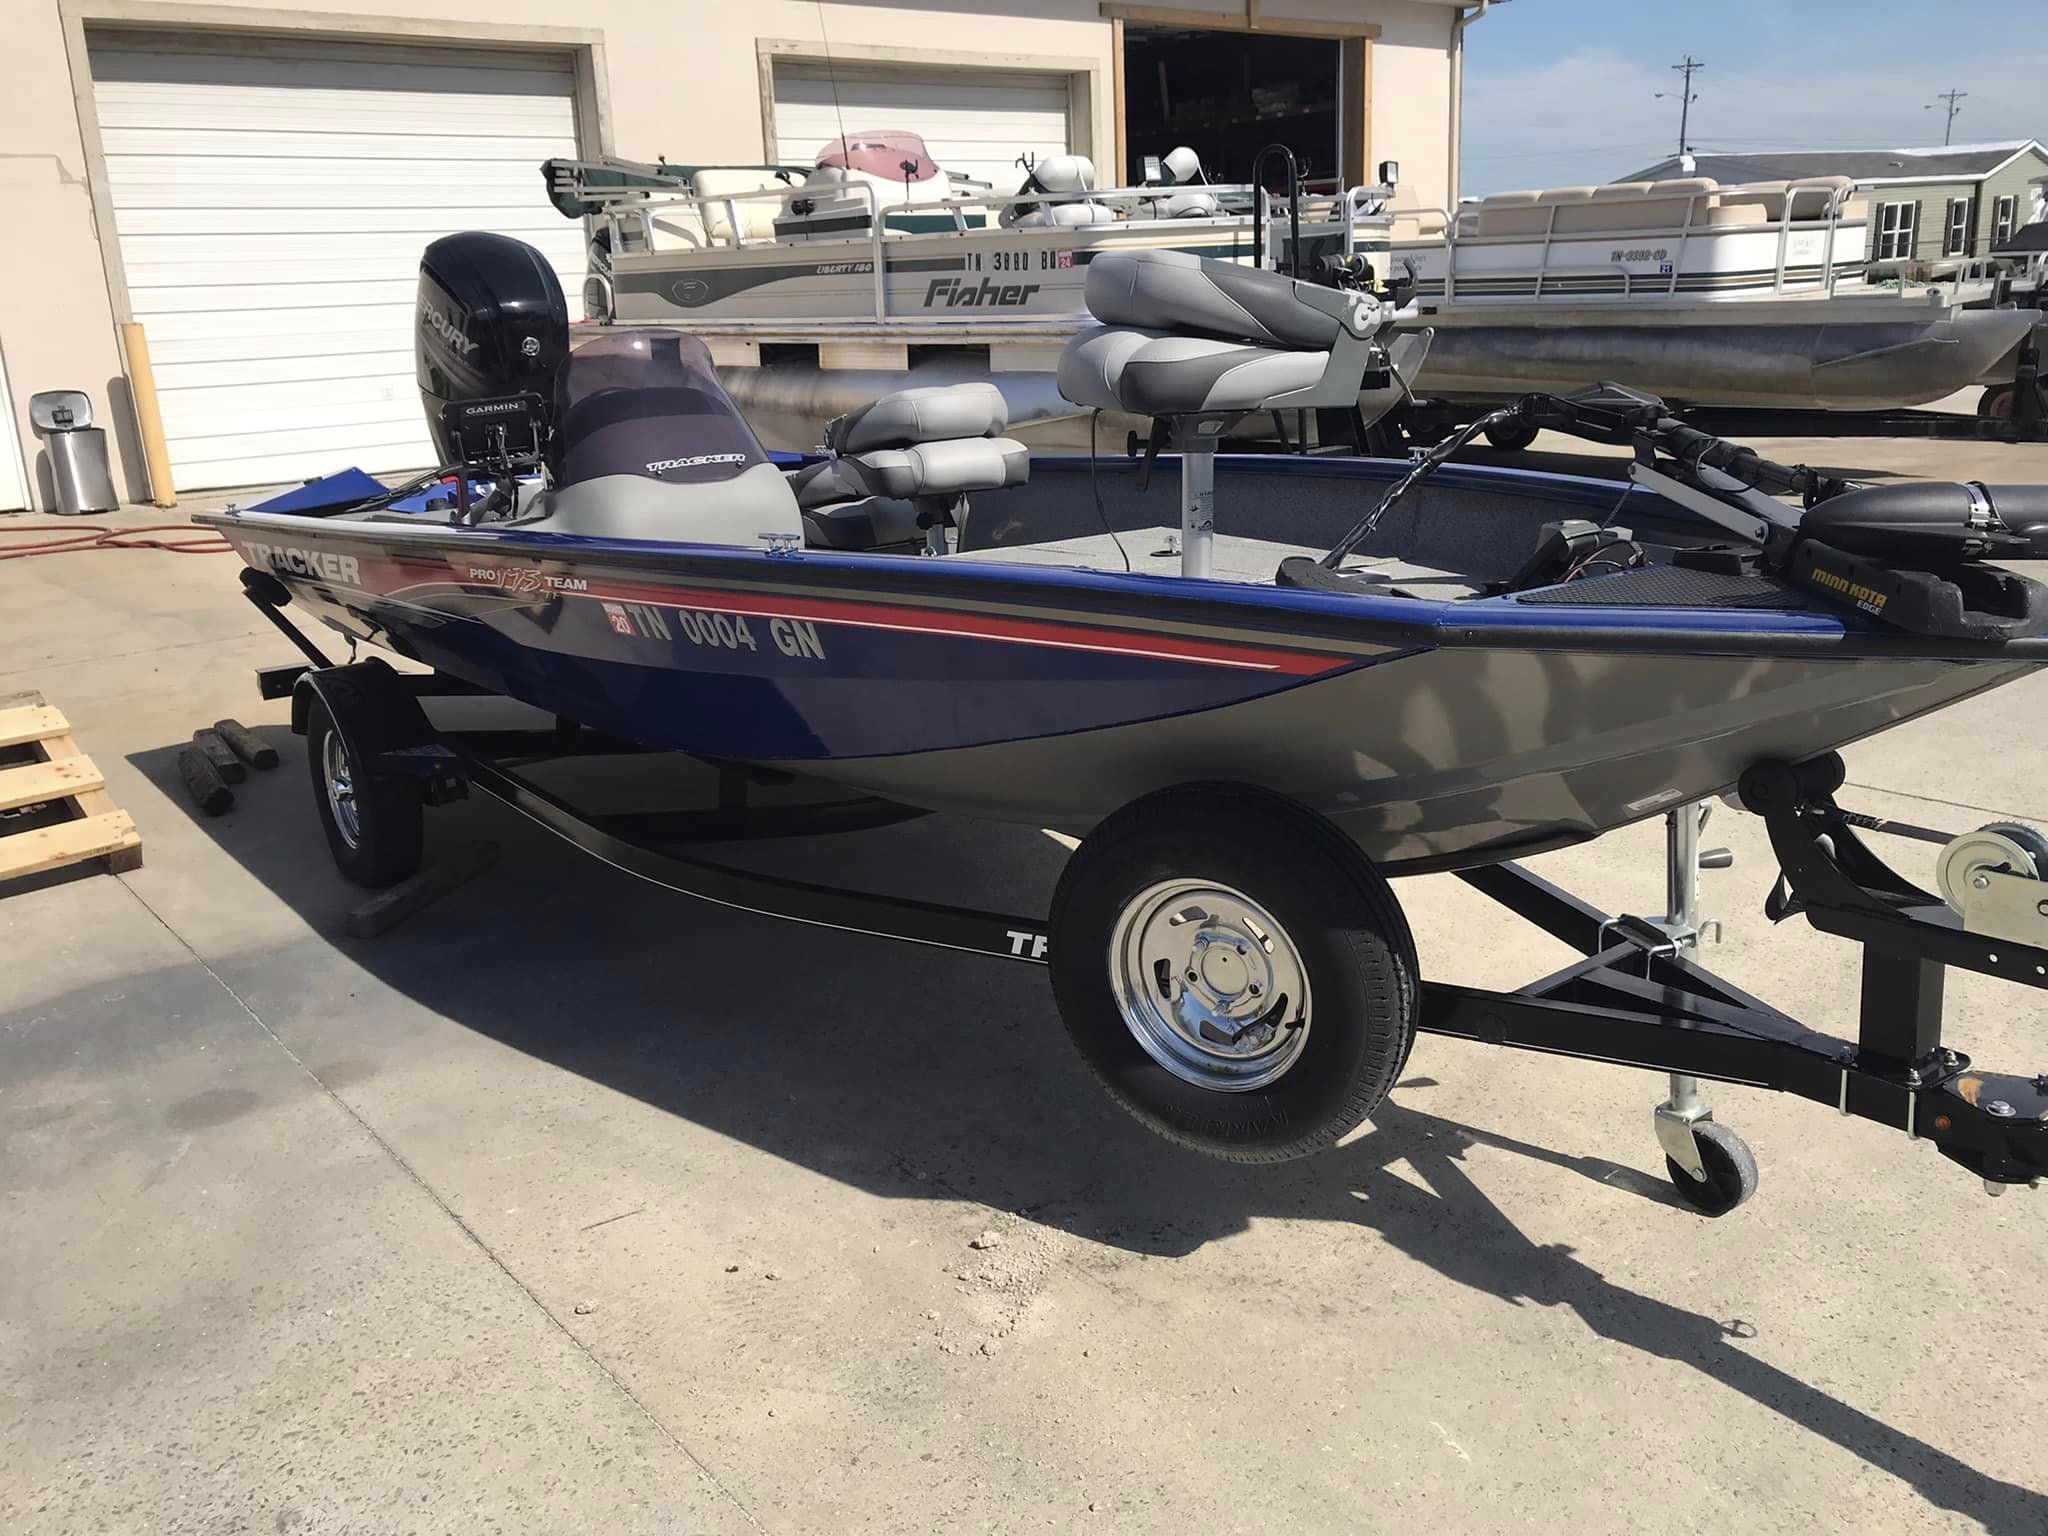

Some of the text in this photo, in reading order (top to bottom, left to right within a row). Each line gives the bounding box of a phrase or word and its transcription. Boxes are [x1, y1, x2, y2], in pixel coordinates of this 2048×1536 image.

[967, 252, 981, 271] TN
[923, 276, 1041, 308] Fisher
[465, 402, 519, 415] GARMIN
[645, 453, 746, 472] TRACKER
[240, 540, 361, 585] TRACKER
[469, 567, 496, 581] PRO
[544, 576, 588, 591] TEAM
[1811, 567, 1888, 608] MINN KOTA
[1856, 599, 1882, 616] EDGE
[624, 603, 826, 661] TN 0004 GN
